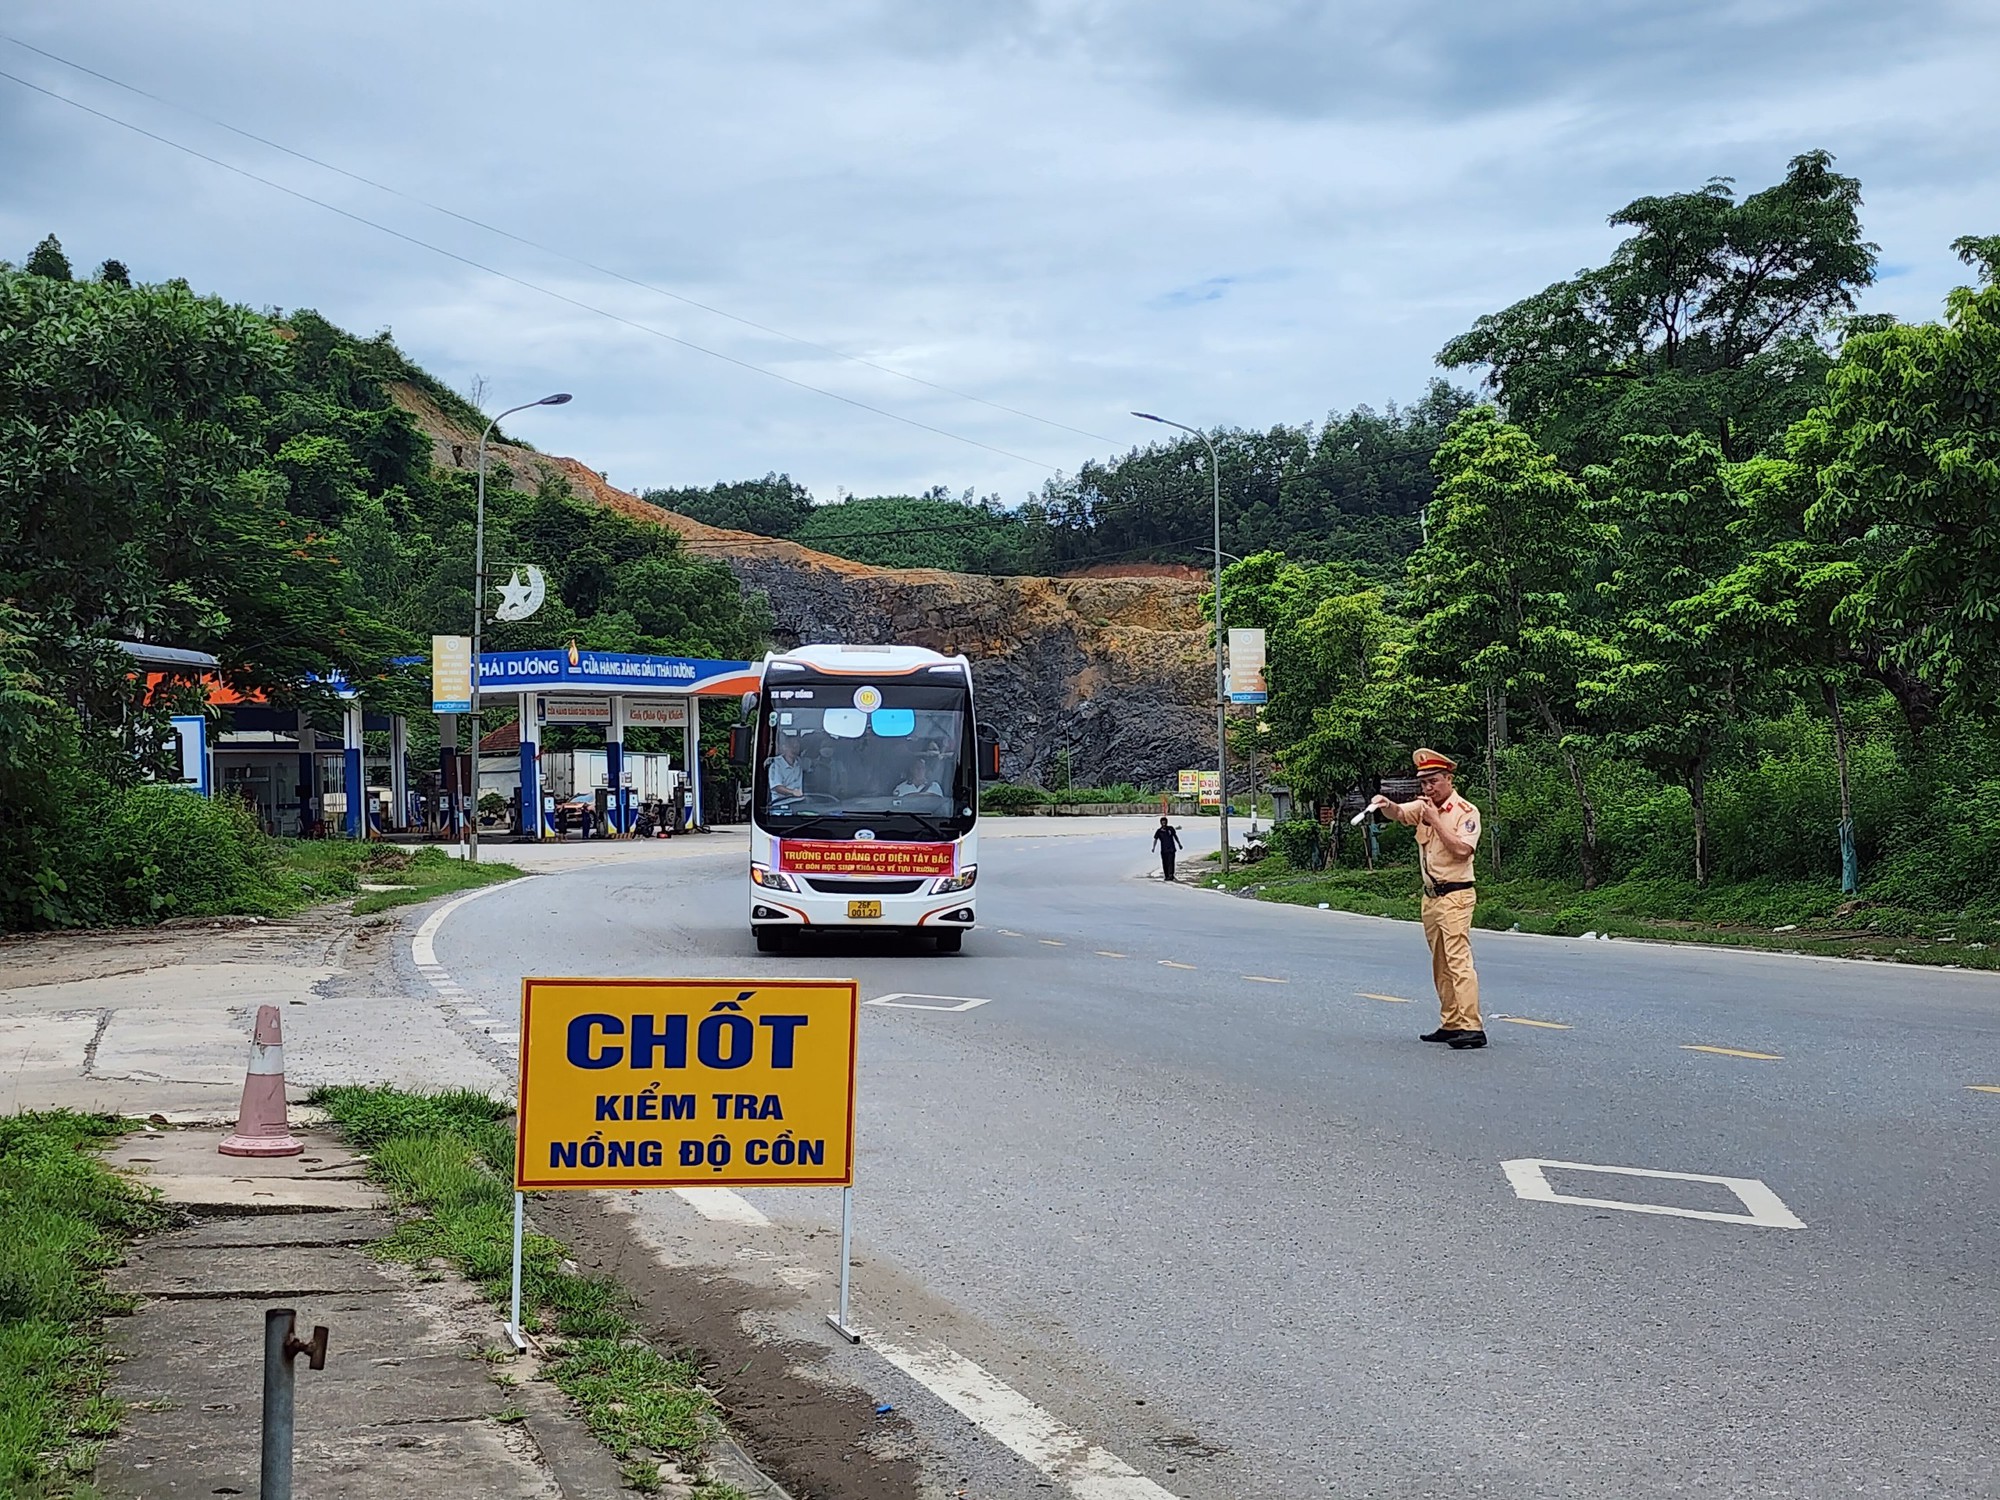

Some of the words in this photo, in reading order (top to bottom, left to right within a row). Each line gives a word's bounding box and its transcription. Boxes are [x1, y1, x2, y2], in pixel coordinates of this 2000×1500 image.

[507, 657, 559, 675] DƯƠNG
[582, 654, 599, 674] CỬA
[600, 657, 620, 676] HÀNG
[621, 659, 641, 676] XĂNG
[656, 661, 672, 678] THÁI
[784, 849, 821, 861] TRƯỜNG
[823, 851, 842, 861] CAO
[844, 849, 870, 862] ĐẲNG
[872, 852, 887, 862] CƠ
[888, 852, 910, 864] ĐIỆN
[912, 852, 930, 863] TÂY
[931, 852, 950, 864] BẮC
[566, 991, 809, 1070] CHỐT
[595, 1081, 696, 1121] KIỂM
[712, 1094, 784, 1120] TRA
[549, 1130, 662, 1168] NỒNG
[678, 1134, 731, 1172] ĐỘ
[745, 1129, 825, 1165] CỒN
